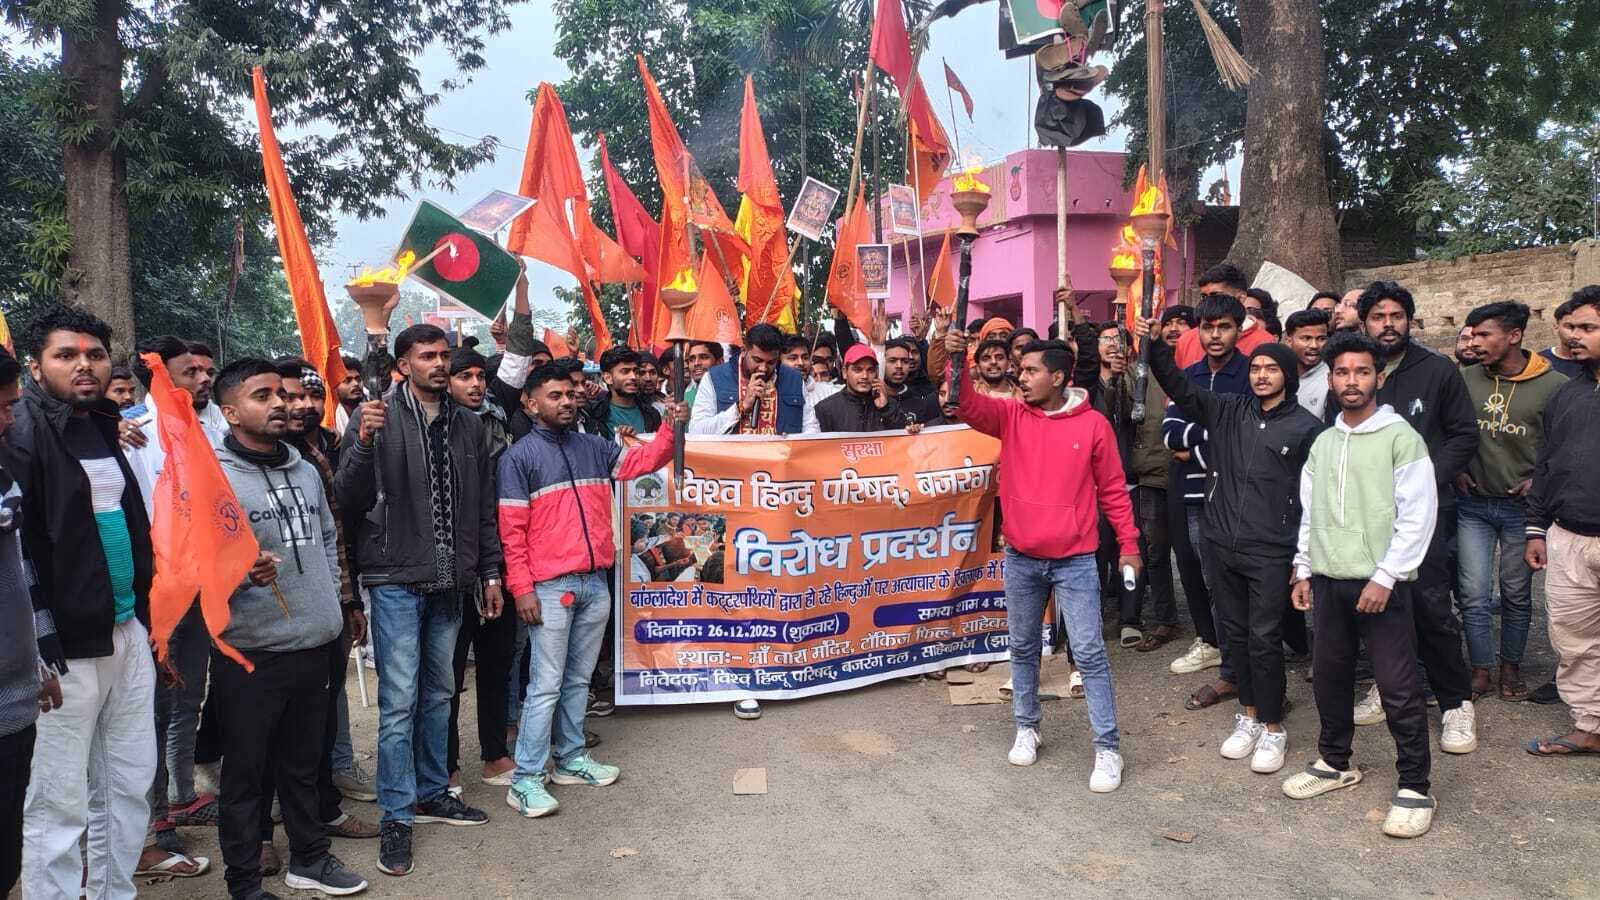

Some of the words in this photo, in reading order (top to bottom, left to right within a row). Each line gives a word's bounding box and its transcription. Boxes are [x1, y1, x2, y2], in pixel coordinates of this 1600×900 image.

[841, 441, 884, 463] सुरक्षा
[914, 455, 993, 497] बजरंग
[733, 527, 852, 577] विरोध
[861, 512, 982, 569] प्रदर्शन
[630, 585, 688, 608] बांग्लादेश
[691, 585, 704, 605] में
[780, 593, 802, 611] द्वारा
[805, 587, 816, 608] हो
[818, 584, 832, 604] रहे
[834, 577, 873, 605] हिन्दुओं
[874, 579, 889, 595] पर
[891, 574, 937, 593] अत्याचार
[937, 569, 951, 589] के
[987, 560, 998, 579] में
[955, 598, 979, 612] शाम
[981, 598, 990, 608] 4
[708, 625, 776, 638] 26.12.2025
[714, 669, 750, 685] विश्व
[755, 670, 792, 687] हिन्दू
[841, 653, 883, 673] बजरंग
[921, 637, 976, 658] साहेबगंज
[773, 648, 807, 664] तारा
